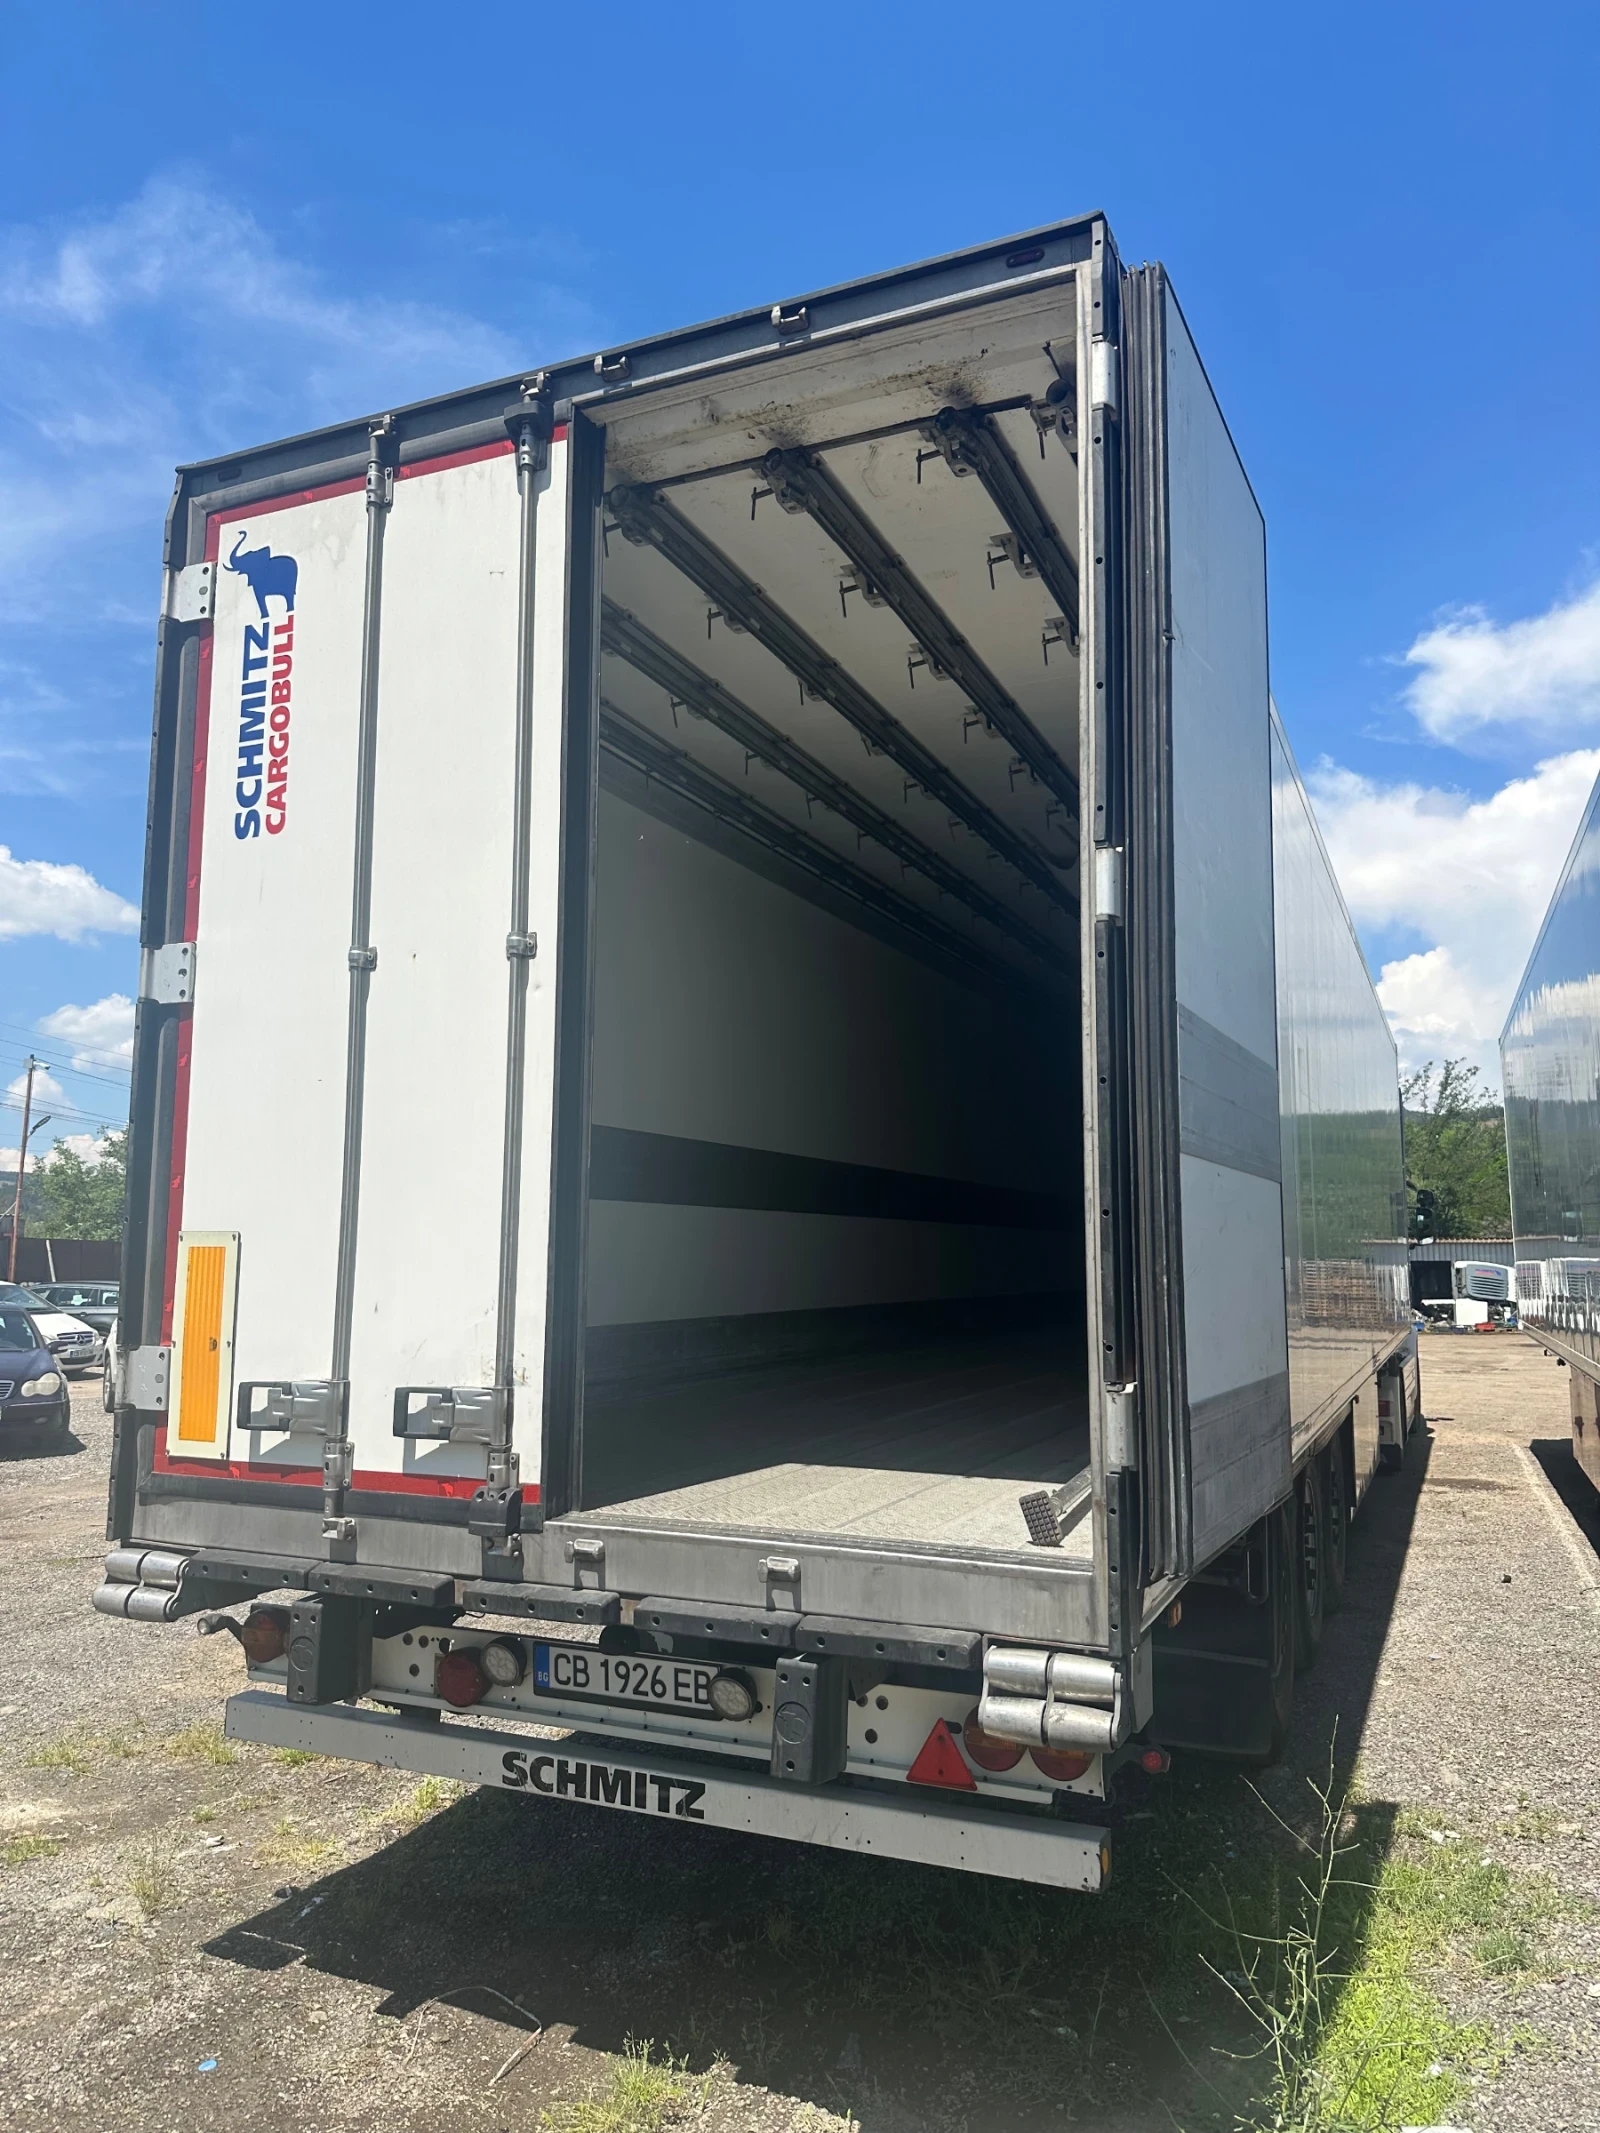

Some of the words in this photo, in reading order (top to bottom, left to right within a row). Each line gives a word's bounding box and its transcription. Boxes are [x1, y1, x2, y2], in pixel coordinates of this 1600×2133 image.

[234, 622, 270, 840] SCHMITZ
[265, 614, 295, 835] CARGOBULL
[537, 1671, 549, 1682] BG
[554, 1653, 590, 1688] CB
[600, 1658, 667, 1699] 1926
[674, 1667, 711, 1705] EB
[501, 1750, 706, 1820] SCHMITZ
